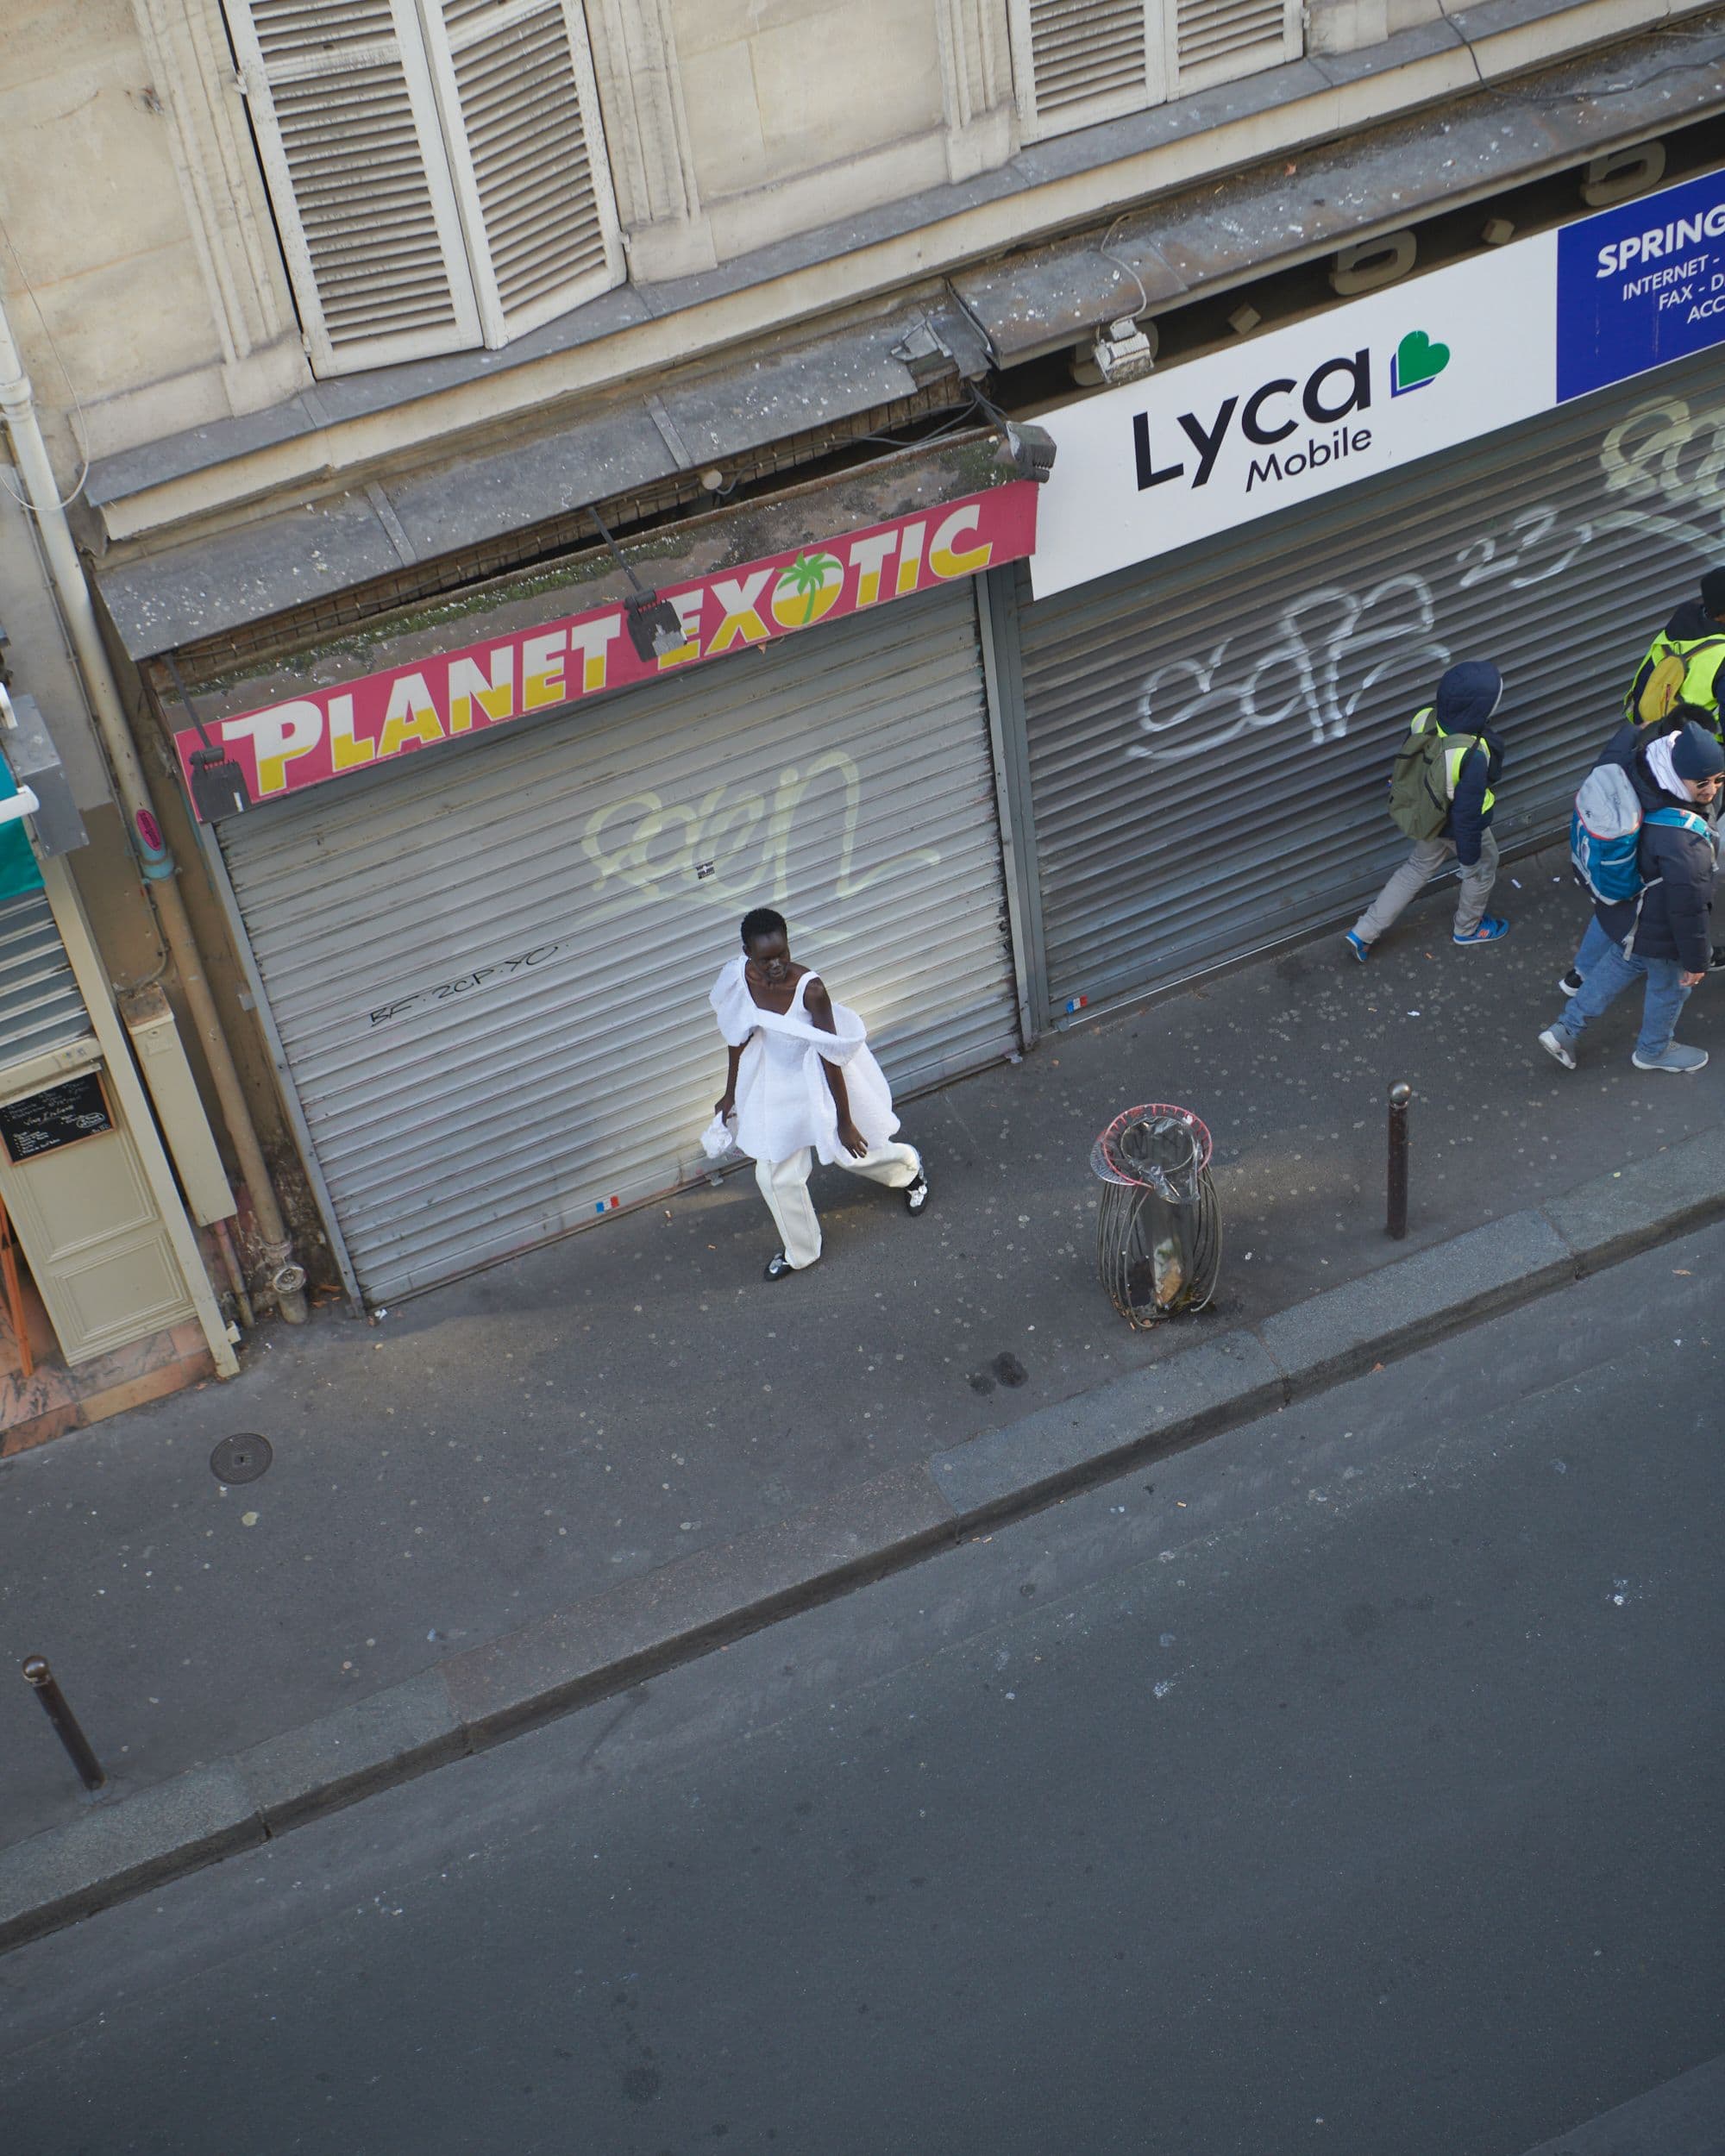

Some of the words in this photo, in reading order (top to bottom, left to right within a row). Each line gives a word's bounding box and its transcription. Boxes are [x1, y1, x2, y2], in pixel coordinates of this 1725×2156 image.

[1622, 254, 1709, 301] INTERNET
[1659, 284, 1693, 311] FAX
[1132, 347, 1371, 492] Lyca
[1245, 427, 1372, 492] Mobile
[221, 613, 622, 797] PLANET
[657, 504, 994, 670] EXOTIC
